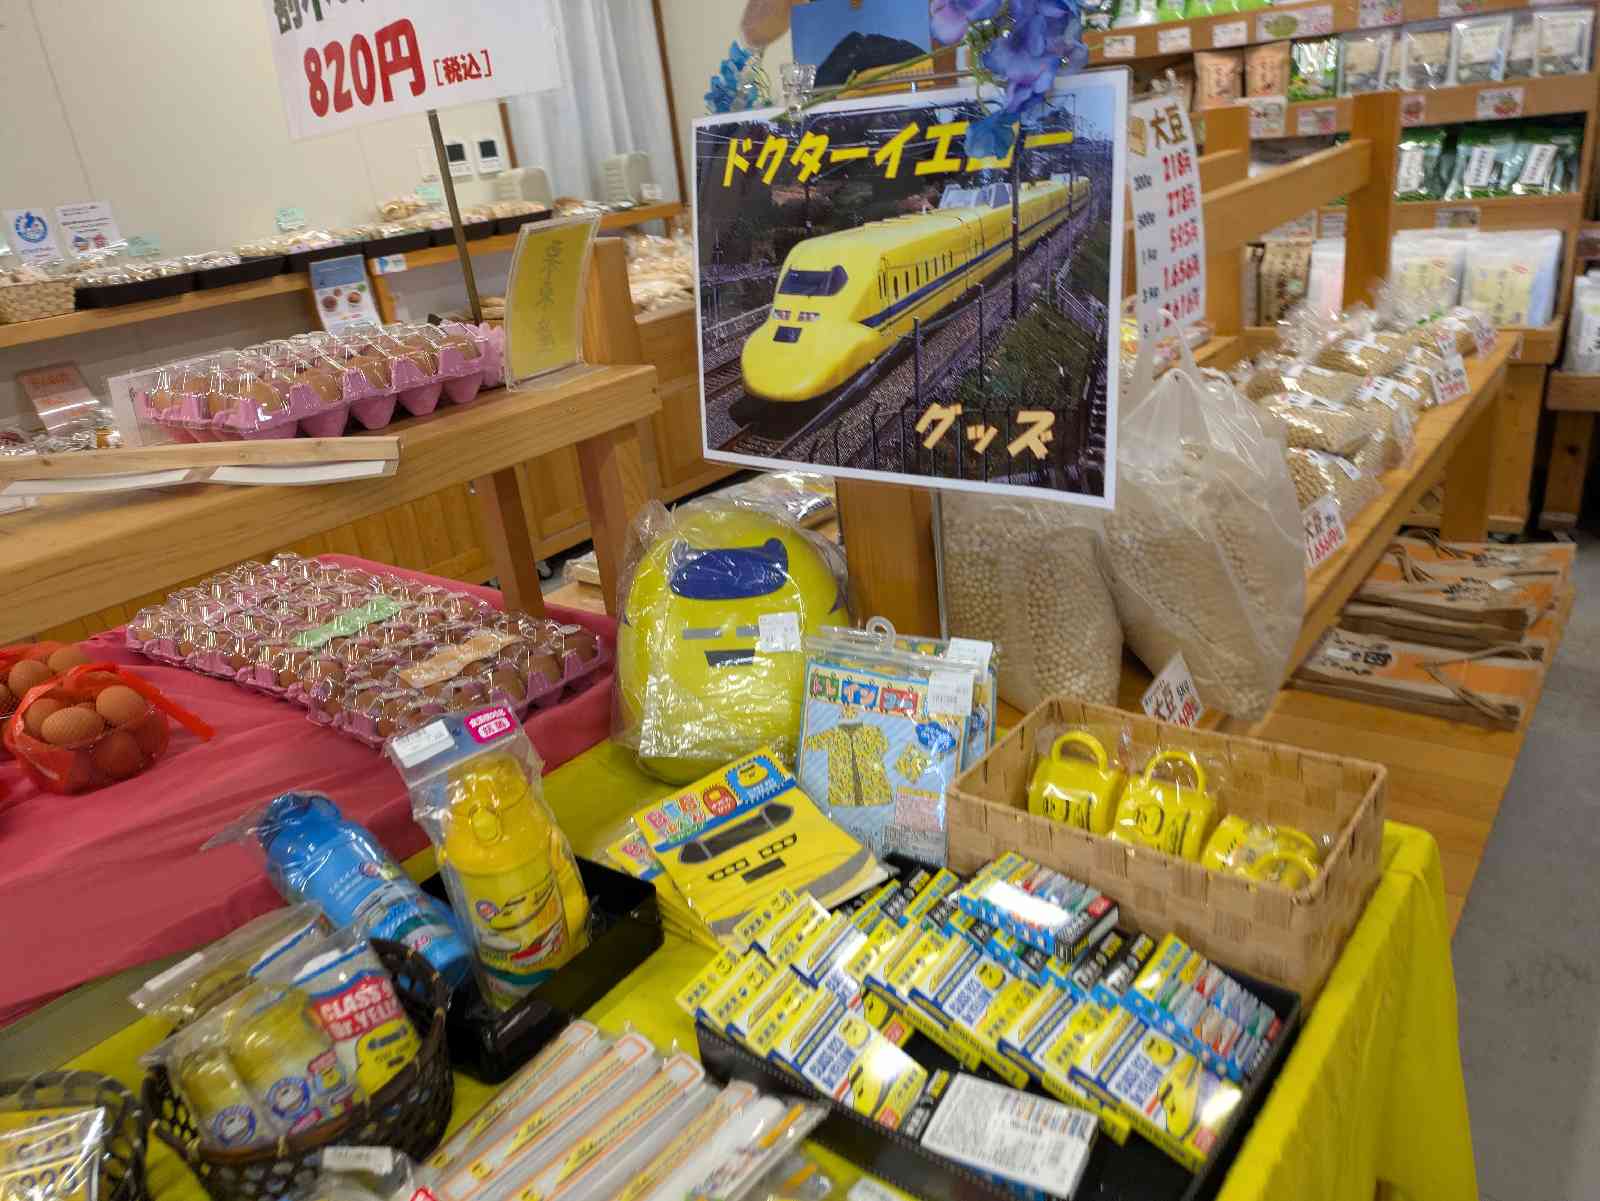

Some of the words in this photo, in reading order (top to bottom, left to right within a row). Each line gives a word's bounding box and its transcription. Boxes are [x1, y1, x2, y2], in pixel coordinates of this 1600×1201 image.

[303, 18, 426, 118] 820円
[432, 49, 493, 86] [税込]
[1150, 103, 1187, 150] 大豆
[914, 401, 1056, 461] グッズ
